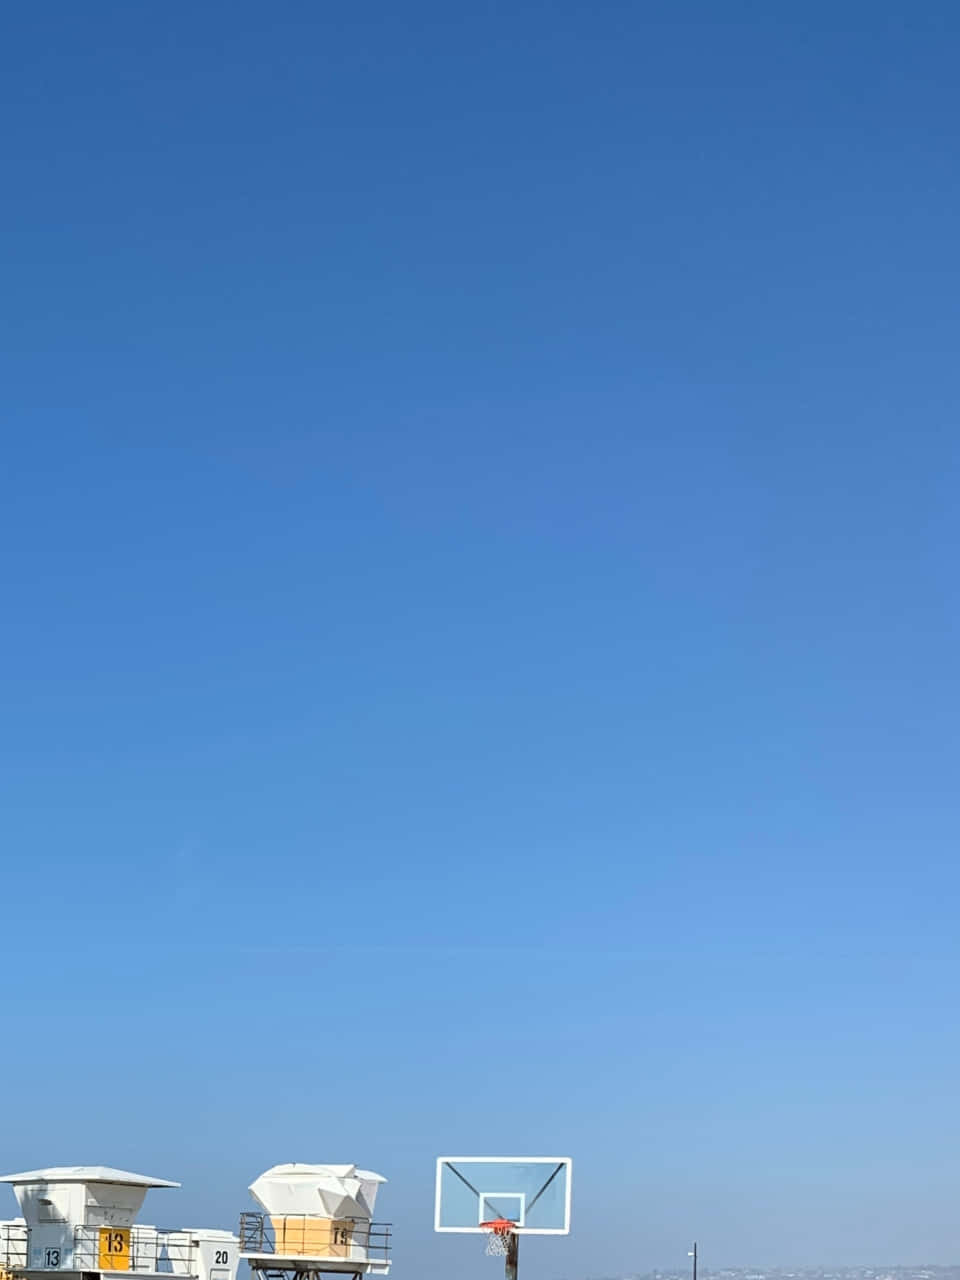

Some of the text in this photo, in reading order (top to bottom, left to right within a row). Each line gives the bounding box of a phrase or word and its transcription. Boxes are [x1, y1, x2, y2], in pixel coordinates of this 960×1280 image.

[105, 1232, 124, 1253] 13
[46, 1250, 60, 1266] 13
[215, 1251, 229, 1264] 20
